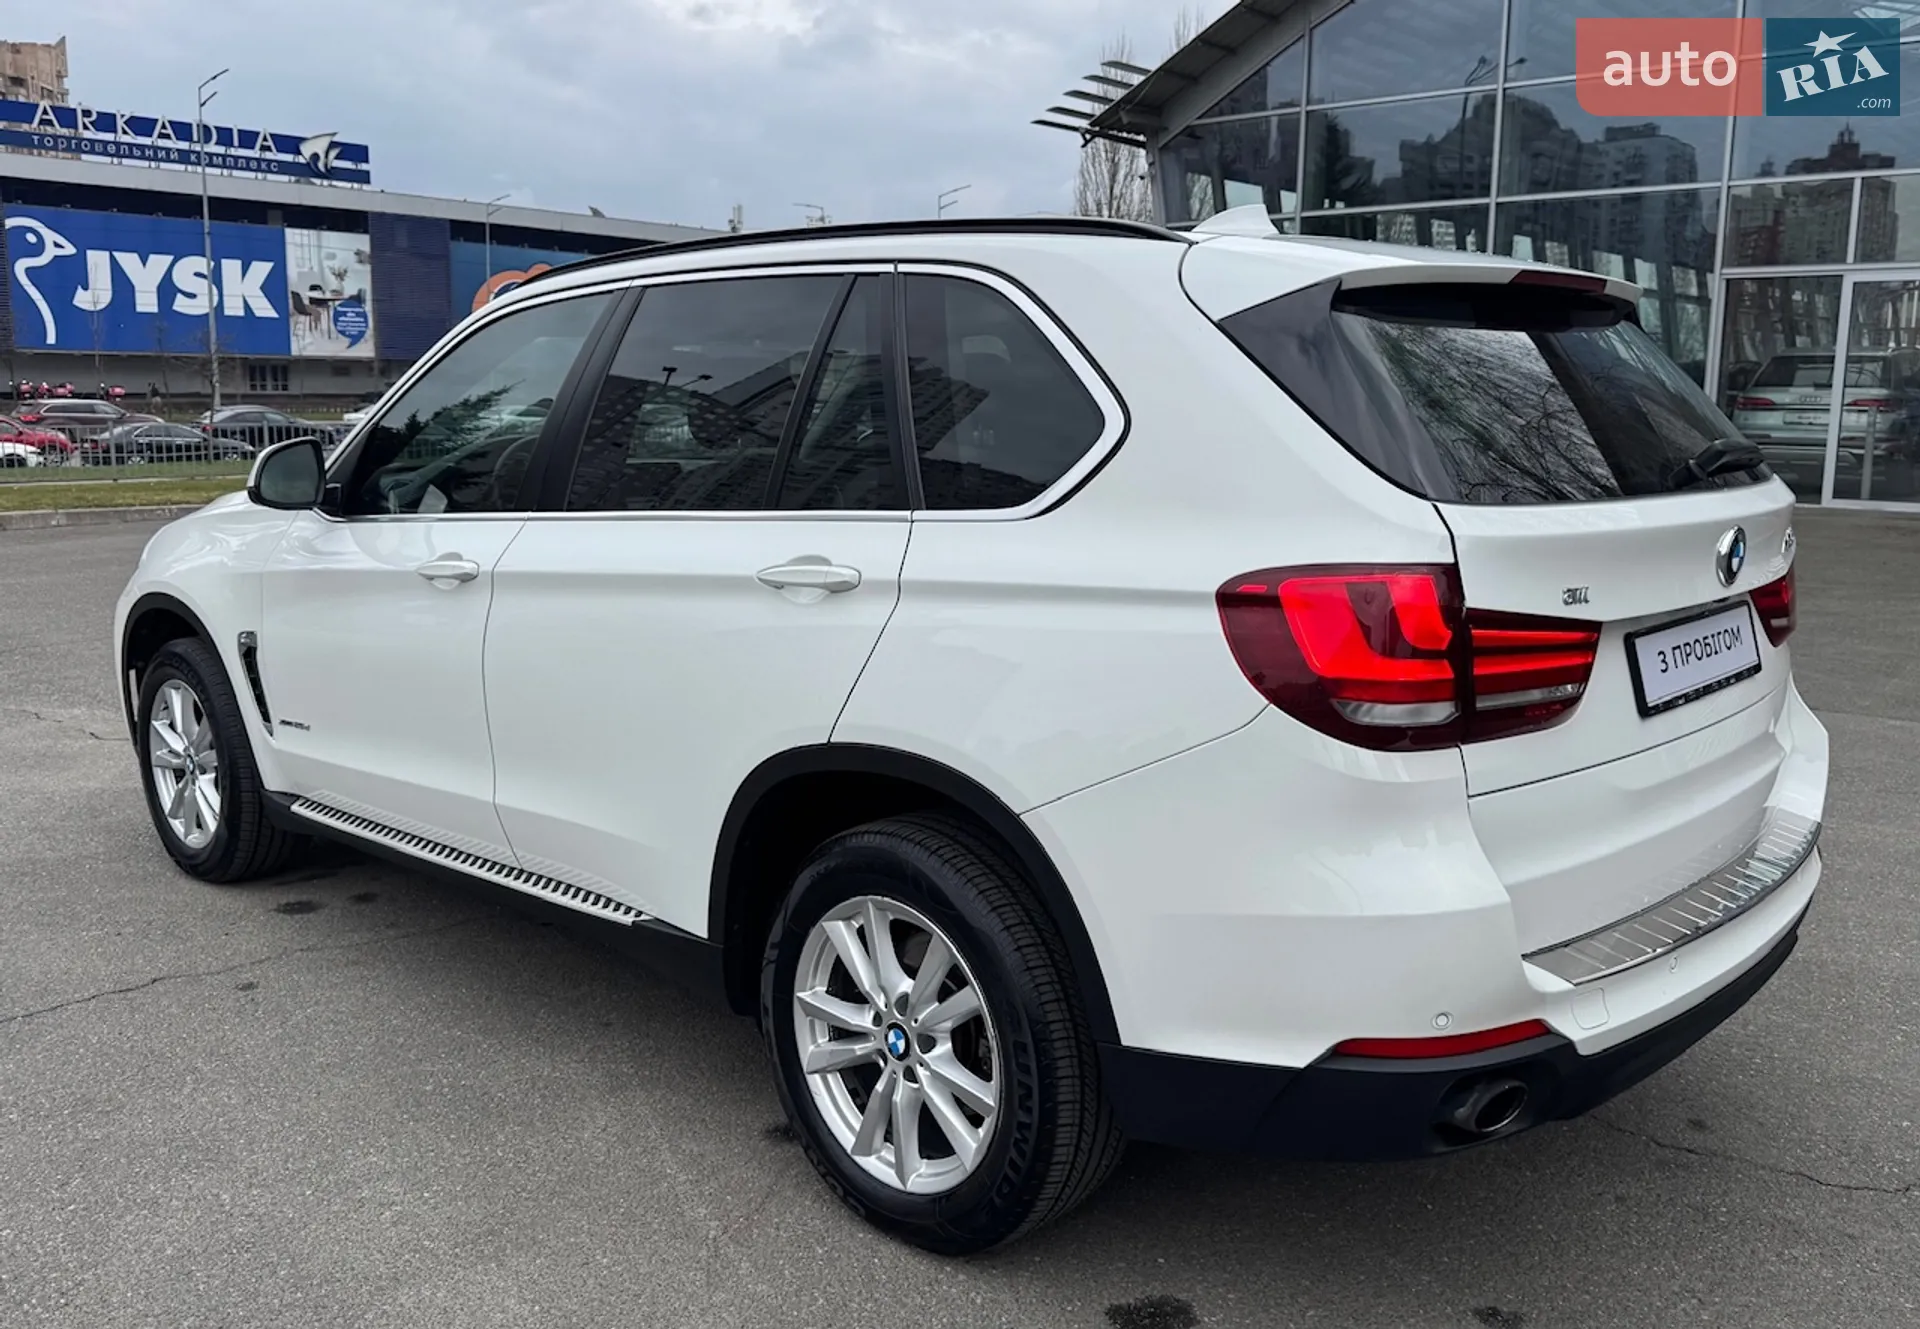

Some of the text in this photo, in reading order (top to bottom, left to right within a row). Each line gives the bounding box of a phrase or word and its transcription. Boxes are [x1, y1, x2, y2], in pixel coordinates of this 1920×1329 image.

[31, 101, 278, 156] ARKADIA
[31, 135, 279, 172] торговельний комплекс
[72, 249, 280, 318] JYSK
[1671, 625, 1744, 670] ПРОБІГОМ
